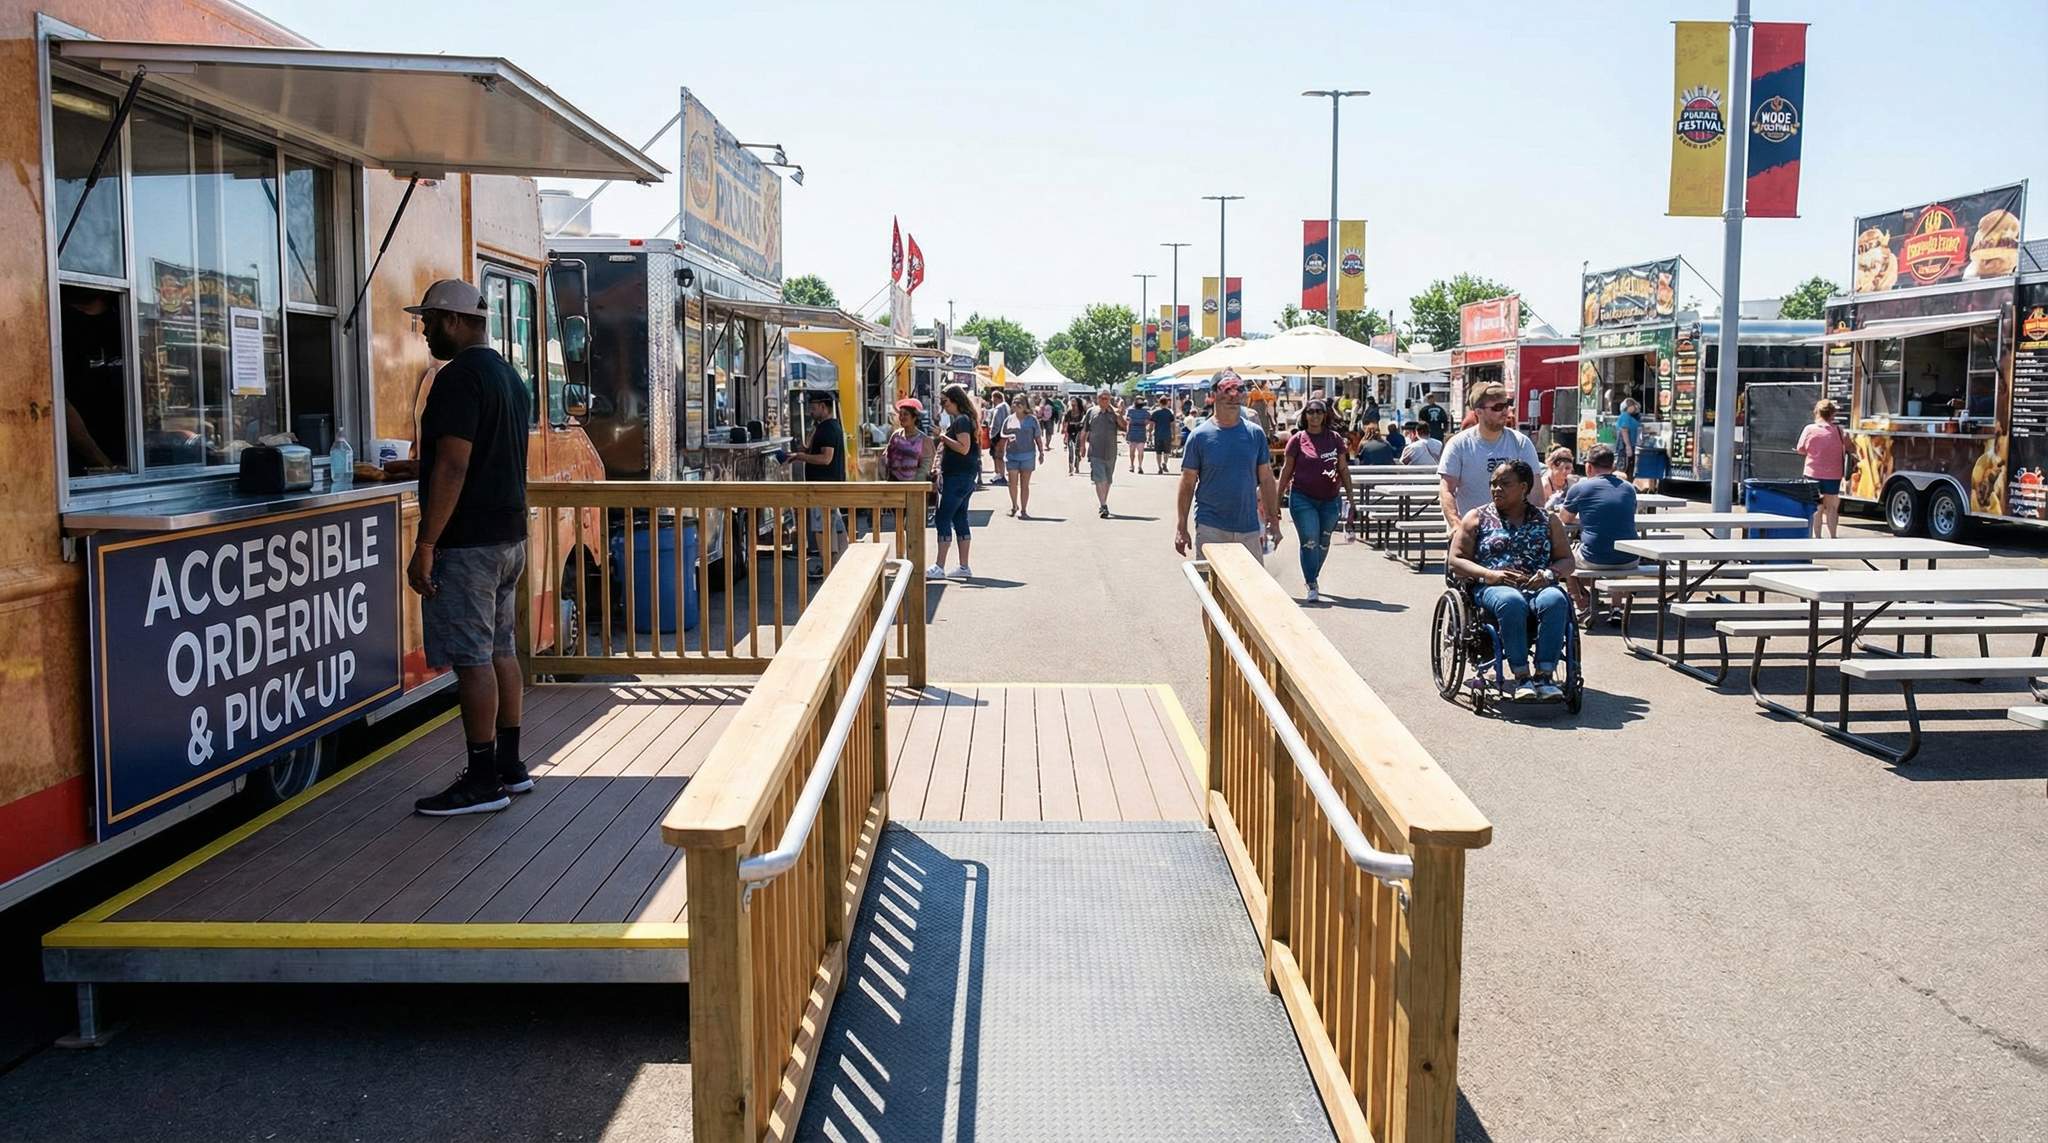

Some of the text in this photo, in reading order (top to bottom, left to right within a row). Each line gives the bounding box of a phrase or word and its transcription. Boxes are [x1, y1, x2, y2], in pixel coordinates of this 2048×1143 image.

[1678, 120, 1724, 132] FESTIVAL
[144, 515, 380, 627] ACCESSIBLE
[167, 582, 369, 697] ORDERING
[187, 650, 356, 766] & PICK-UP
